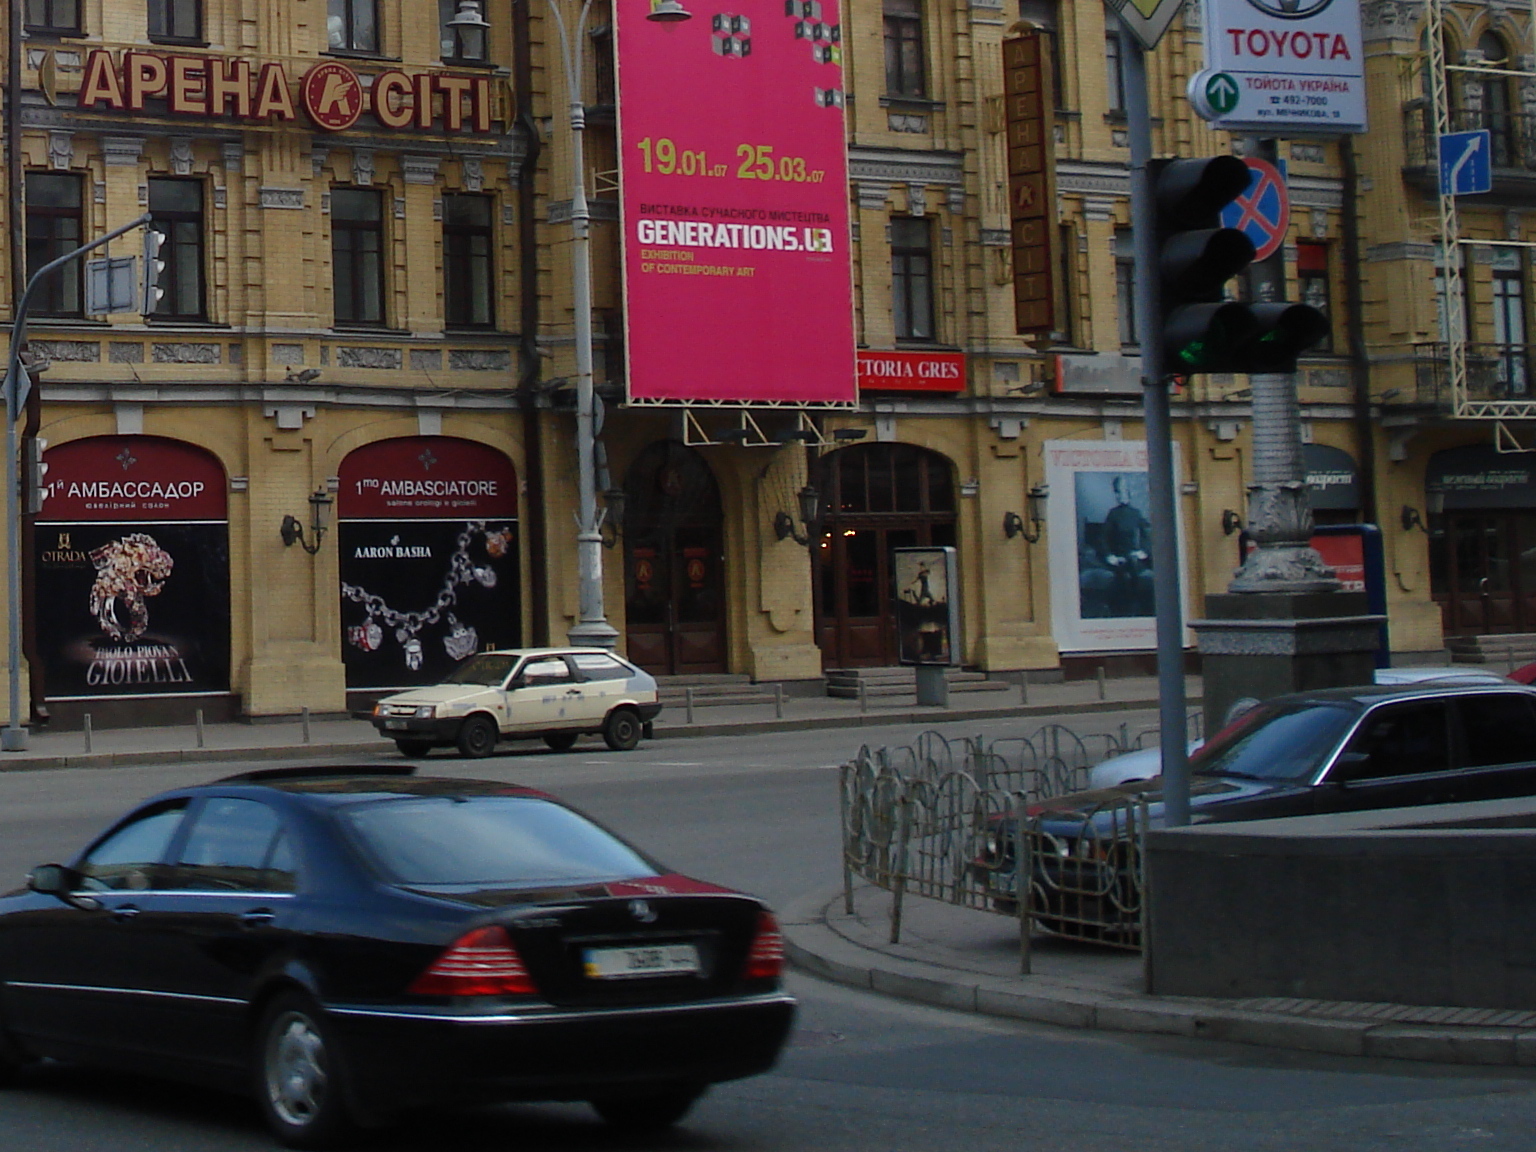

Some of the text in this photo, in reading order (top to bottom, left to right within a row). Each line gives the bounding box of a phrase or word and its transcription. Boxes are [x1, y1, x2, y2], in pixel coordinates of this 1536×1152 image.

[1226, 28, 1352, 61] TOYOTA
[77, 49, 296, 121] АРЕНА
[1244, 75, 1351, 94] ТОЙОТА УКРАЇНА
[637, 136, 825, 183] 19.01.07 25.03.07
[640, 203, 830, 224] ВИСТАВКА СУЧАСНОГО МИСТЕЦТВА
[641, 249, 694, 262] EXHIBITION
[641, 263, 756, 278] OF CONTEMPORARY ART
[917, 360, 960, 379] GRES
[67, 480, 205, 499] АМБАССАДОР
[381, 480, 498, 496] AMBASCIATORE
[42, 550, 87, 563] OTRADA
[355, 546, 432, 559] AARON BASHA
[86, 656, 194, 686] GIOIELLI
